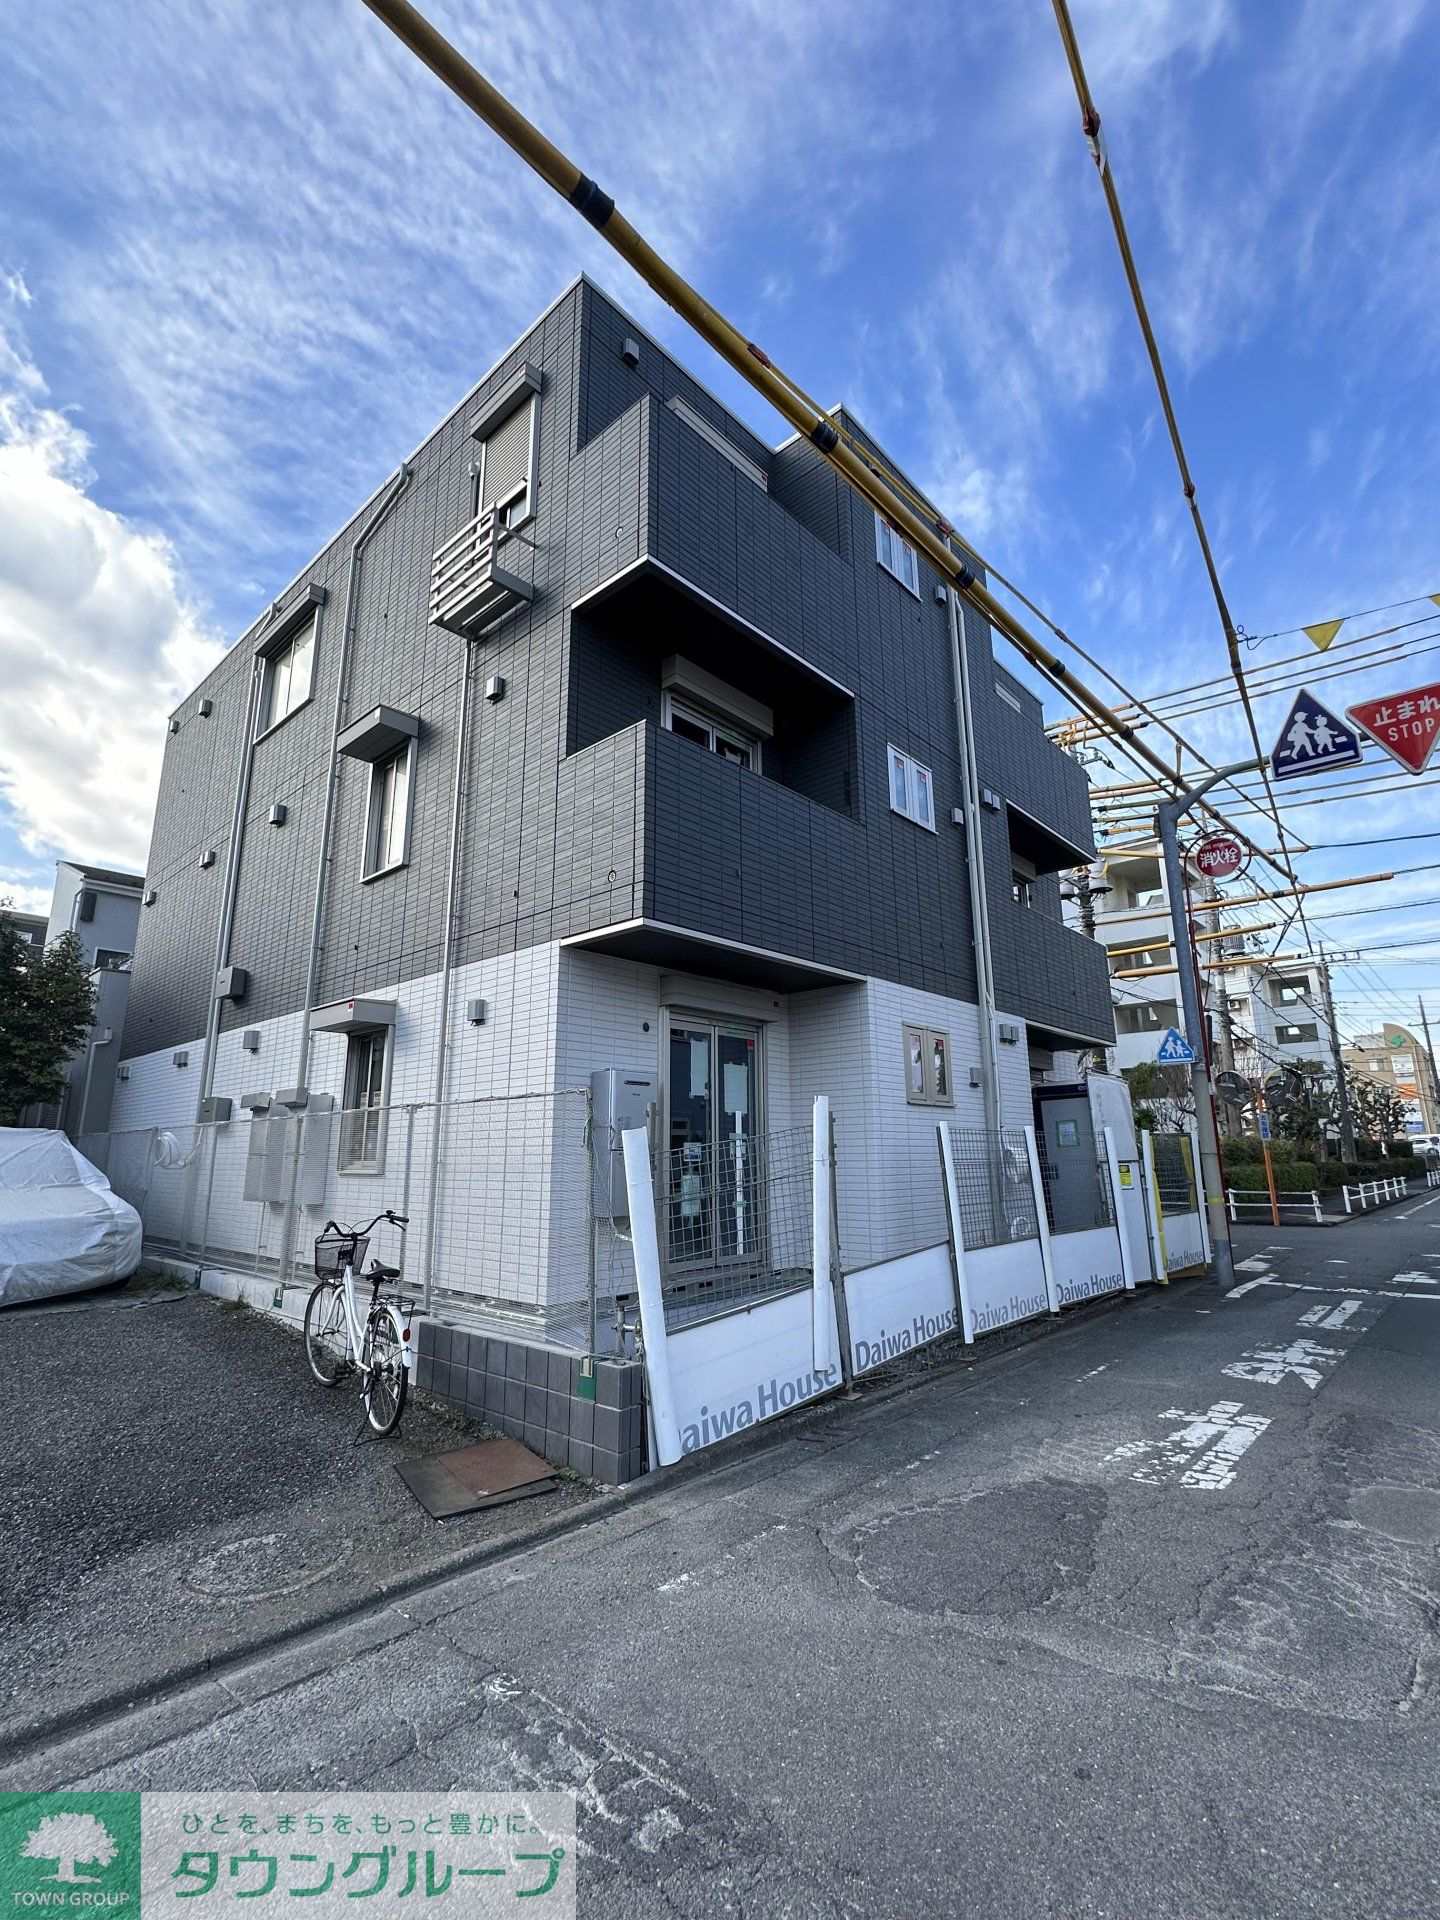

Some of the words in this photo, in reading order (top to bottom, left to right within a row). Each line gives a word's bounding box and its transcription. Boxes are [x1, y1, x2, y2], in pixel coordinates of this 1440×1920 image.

[1373, 694, 1440, 726] 止まれ
[1388, 717, 1435, 741] STOP
[1200, 846, 1239, 868] 消火栓
[1166, 1252, 1183, 1271] aiwa
[1183, 1250, 1203, 1267] House
[1090, 1272, 1122, 1294] House
[1009, 1293, 1046, 1320] House
[855, 1329, 912, 1373] Daiwa
[912, 1307, 960, 1344] House
[677, 1400, 754, 1453] aiwa
[757, 1363, 837, 1418] House
